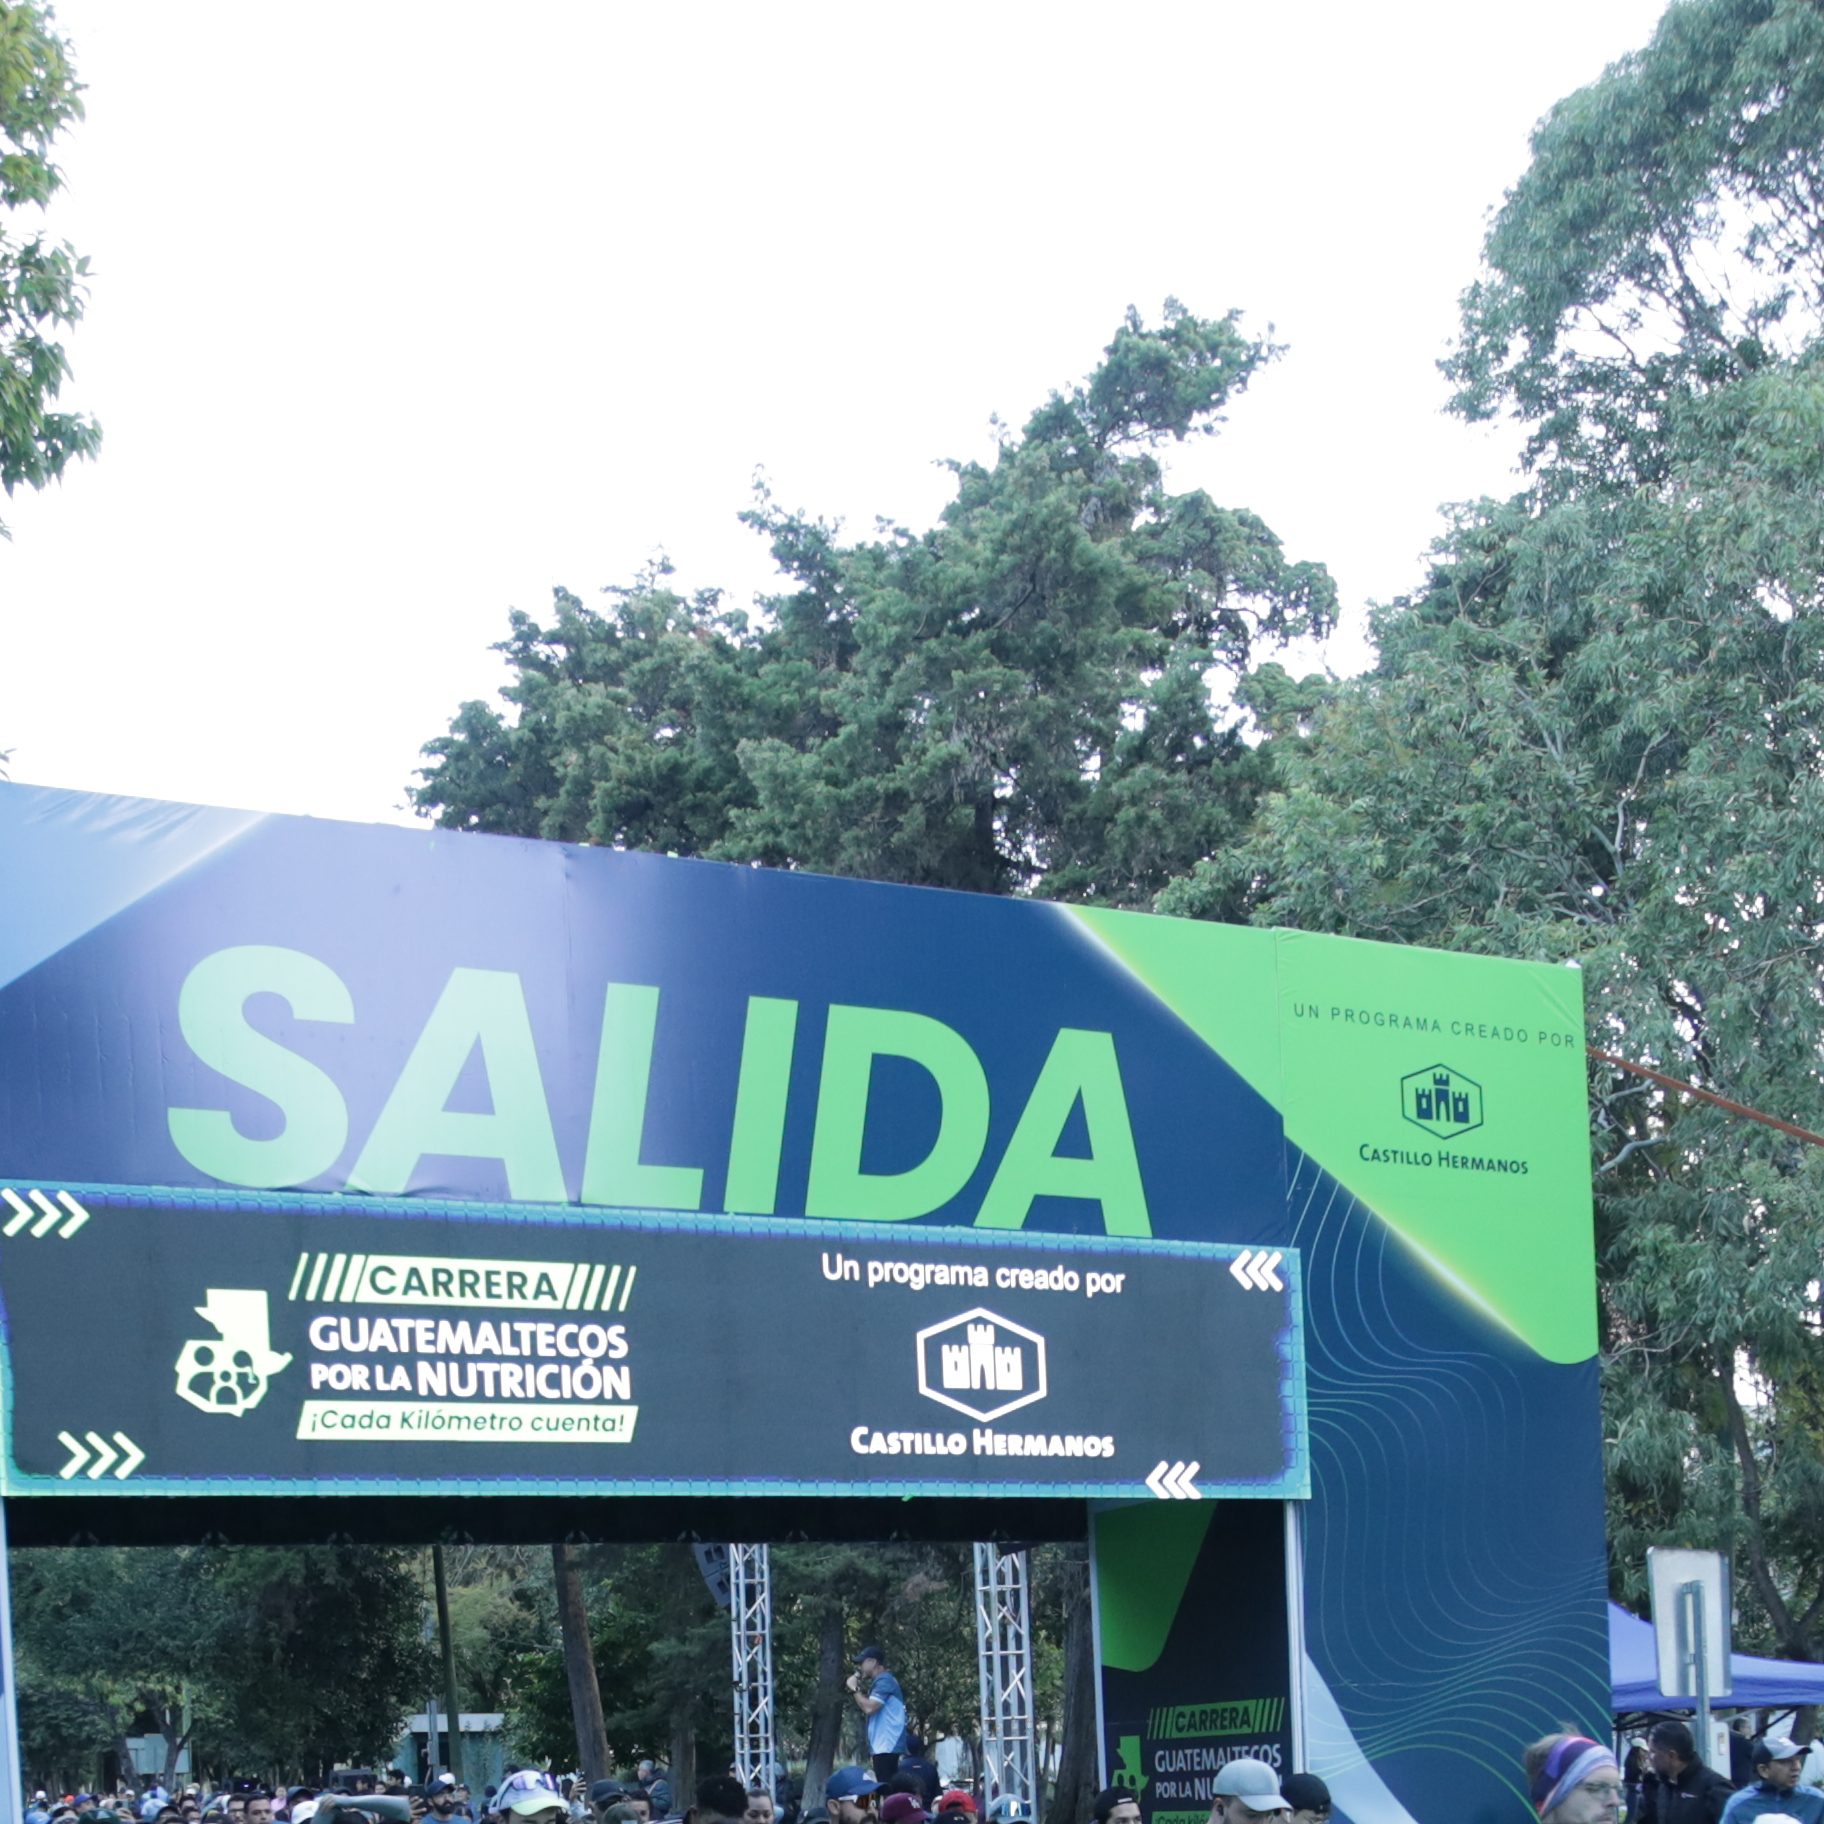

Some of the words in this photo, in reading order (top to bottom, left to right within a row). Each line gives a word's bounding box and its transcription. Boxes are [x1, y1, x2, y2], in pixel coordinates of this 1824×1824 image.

[1293, 1002, 1320, 1019] UN
[1331, 1006, 1443, 1034] PROGRAMA
[1450, 1021, 1528, 1043] CREADO
[1538, 1031, 1575, 1048] POR
[167, 944, 1153, 1238] SALIDA
[1359, 1143, 1433, 1167] CASTILLO
[1438, 1150, 1529, 1174] HERMANOS
[368, 1264, 559, 1302] CARRERA
[821, 1253, 860, 1281] Un
[867, 1259, 989, 1291] programa
[995, 1264, 1080, 1291] creado
[1086, 1270, 1125, 1298] por
[308, 1315, 629, 1358] GUATEMALTECOS
[310, 1362, 371, 1391] POR
[375, 1364, 412, 1391] LA
[417, 1357, 632, 1400] NUTRICIÓN
[311, 1409, 392, 1434] ¡Cada
[399, 1407, 523, 1433] Kilómetro
[530, 1410, 625, 1433] cuenta!
[850, 1426, 967, 1456] CASTILLO
[973, 1428, 1116, 1459] HERMANOS
[1176, 1706, 1251, 1733] CARRERA
[1155, 1781, 1177, 1799] POR
[1178, 1781, 1192, 1799] LA
